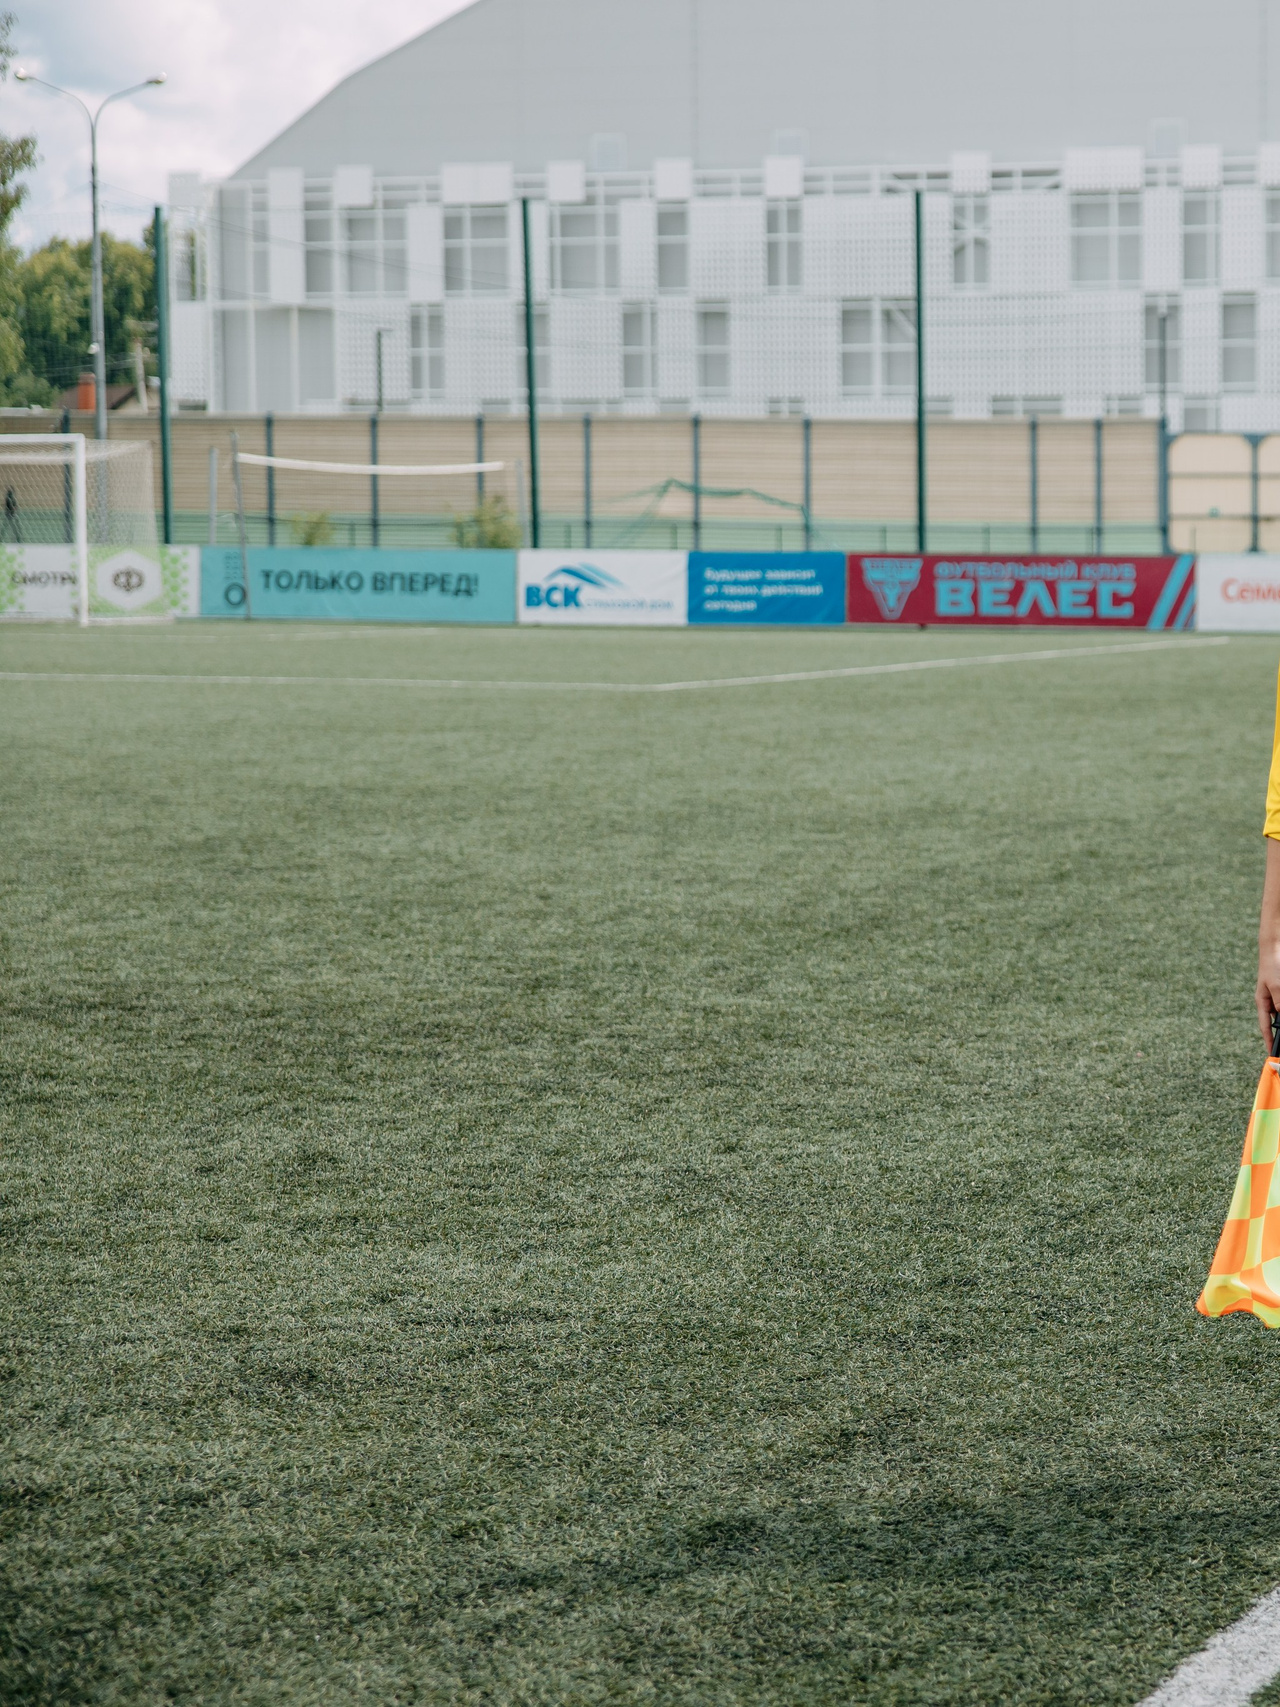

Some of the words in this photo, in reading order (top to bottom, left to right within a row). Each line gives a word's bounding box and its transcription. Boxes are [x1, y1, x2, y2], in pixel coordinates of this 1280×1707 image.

[934, 561, 1077, 579] ФУТБОЛЬНЫЙ
[1082, 563, 1136, 579] КЛУБ
[261, 569, 363, 591] ТОЛЬКО
[372, 572, 479, 597] ВПЕРЕД!
[526, 586, 581, 608] ВСК
[934, 579, 1136, 618] ВЕЛЕС
